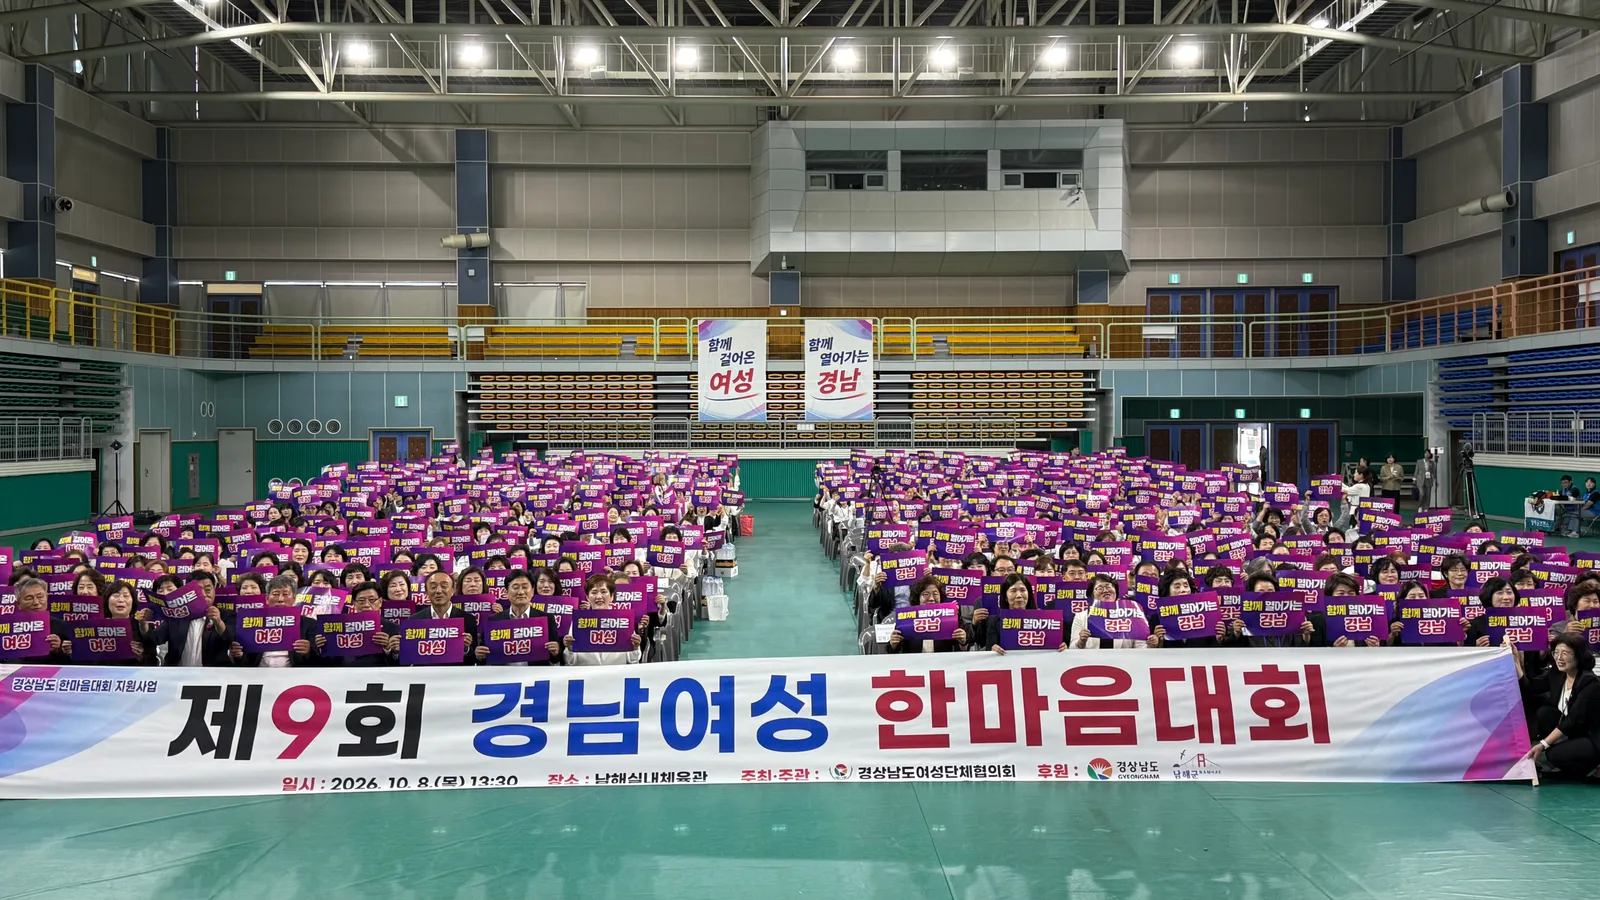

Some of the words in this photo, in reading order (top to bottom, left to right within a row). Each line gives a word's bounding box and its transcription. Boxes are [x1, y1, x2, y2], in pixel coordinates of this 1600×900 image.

[708, 337, 733, 352] 함께
[808, 337, 834, 352] 함께
[719, 350, 756, 367] 걸어온
[820, 349, 869, 366] 열어가는
[709, 368, 755, 395] 여성
[817, 367, 861, 395] 경남
[582, 521, 599, 529] 여성
[1376, 516, 1400, 527] 열어가는
[106, 530, 123, 540] 여성
[369, 526, 388, 534] 걸어온
[882, 530, 907, 538] 열어가는
[996, 527, 1015, 538] 경남
[936, 532, 950, 541] 함께
[951, 533, 974, 543] 열어가는
[1375, 537, 1388, 545] 함께
[1501, 536, 1516, 544] 함께
[1516, 537, 1542, 546] 열어가는
[194, 544, 215, 552] 걸어온
[650, 545, 663, 553] 함께
[663, 545, 682, 554] 걸어온
[946, 542, 965, 554] 경남
[1143, 541, 1156, 549] 함께
[1158, 542, 1185, 550] 열어가는
[1217, 544, 1230, 552] 함께
[1231, 538, 1251, 550] 열어가는
[358, 547, 381, 556] 걸어온
[487, 549, 506, 557] 걸어온
[562, 552, 577, 560] 함께
[578, 552, 602, 560] 걸어온
[613, 548, 632, 556] 걸어온
[1154, 551, 1174, 561] 경남
[1229, 548, 1247, 560] 경남
[607, 556, 624, 567] 여성
[657, 553, 674, 563] 여성
[883, 560, 898, 569] 함께
[899, 558, 926, 567] 열어가는
[1480, 562, 1511, 570] 열어가는
[896, 567, 917, 580] 경남
[1400, 570, 1430, 579] 열어가는
[933, 575, 949, 584] 함께
[950, 577, 981, 586] 열어가는
[1279, 577, 1296, 587] 함께
[616, 591, 642, 601] 걸어온
[946, 586, 968, 598] 경남
[1057, 589, 1074, 599] 함께
[167, 590, 198, 607] 걸어온
[314, 594, 341, 605] 걸어온
[1529, 597, 1563, 607] 열어가는
[50, 602, 71, 612] 함께
[72, 603, 99, 613] 걸어온
[464, 602, 491, 612] 걸어온
[546, 604, 574, 615] 걸어온
[1159, 604, 1179, 616] 함께
[1180, 601, 1218, 613] 열어가는
[1243, 600, 1263, 611] 함께
[1265, 600, 1302, 611] 열어가는
[1326, 605, 1346, 615] 함께
[1348, 605, 1384, 616] 열어가는
[162, 606, 189, 618] 여성
[384, 608, 411, 617] 걸어온
[898, 611, 917, 619] 함께
[918, 608, 955, 618] 열어가는
[1090, 606, 1107, 617] 함께
[1109, 606, 1146, 618] 열어가는
[1402, 608, 1420, 618] 함께
[1422, 608, 1460, 618] 열어가는
[243, 616, 264, 627] 함께
[265, 616, 295, 627] 걸어온
[323, 622, 343, 632] 함께
[345, 620, 375, 632] 걸어온
[578, 618, 598, 629] 함께
[600, 618, 630, 629] 걸어온
[914, 618, 941, 632] 경남
[1002, 618, 1021, 629] 함께
[1023, 618, 1061, 629] 열어가는
[1105, 618, 1132, 632] 경남
[1177, 615, 1205, 631] 경남
[1259, 613, 1288, 628] 경남
[1344, 616, 1372, 632] 경남
[1488, 616, 1507, 626] 함께
[1509, 615, 1546, 626] 열어가는
[13, 621, 44, 632] 걸어온
[74, 627, 95, 637] 함께
[97, 627, 126, 636] 걸어온
[1419, 620, 1446, 635] 경남
[255, 628, 282, 643] 여성
[405, 628, 426, 639] 함께
[429, 628, 459, 639] 걸어온
[490, 630, 511, 640] 함께
[513, 627, 543, 639] 걸어온
[590, 631, 617, 645] 여성
[1018, 631, 1045, 646] 경남
[1505, 628, 1533, 642] 경남
[3, 634, 31, 650] 여성
[89, 638, 116, 652] 여성
[337, 633, 363, 648] 여성
[418, 640, 446, 655] 여성
[504, 640, 531, 656] 여성
[13, 679, 56, 692] 경상남도
[59, 680, 113, 693] 한마음대회
[115, 680, 158, 693] 지원사업
[166, 683, 426, 761] 제9회
[470, 672, 830, 760] 경남여성
[870, 663, 1331, 750] 한마음대회
[858, 765, 1016, 780] 경상남도여성단체협의회
[1037, 763, 1069, 779] 후원
[1117, 761, 1159, 773] 경상남도
[548, 774, 579, 785] 장소
[595, 771, 708, 784] 남해실내체육관
[740, 769, 810, 781] 주최·주관
[1173, 770, 1199, 779] 남해군
[282, 777, 315, 791] 일시
[330, 777, 381, 790] 2026.
[388, 776, 411, 788] 10.
[470, 775, 518, 786] 13:30
